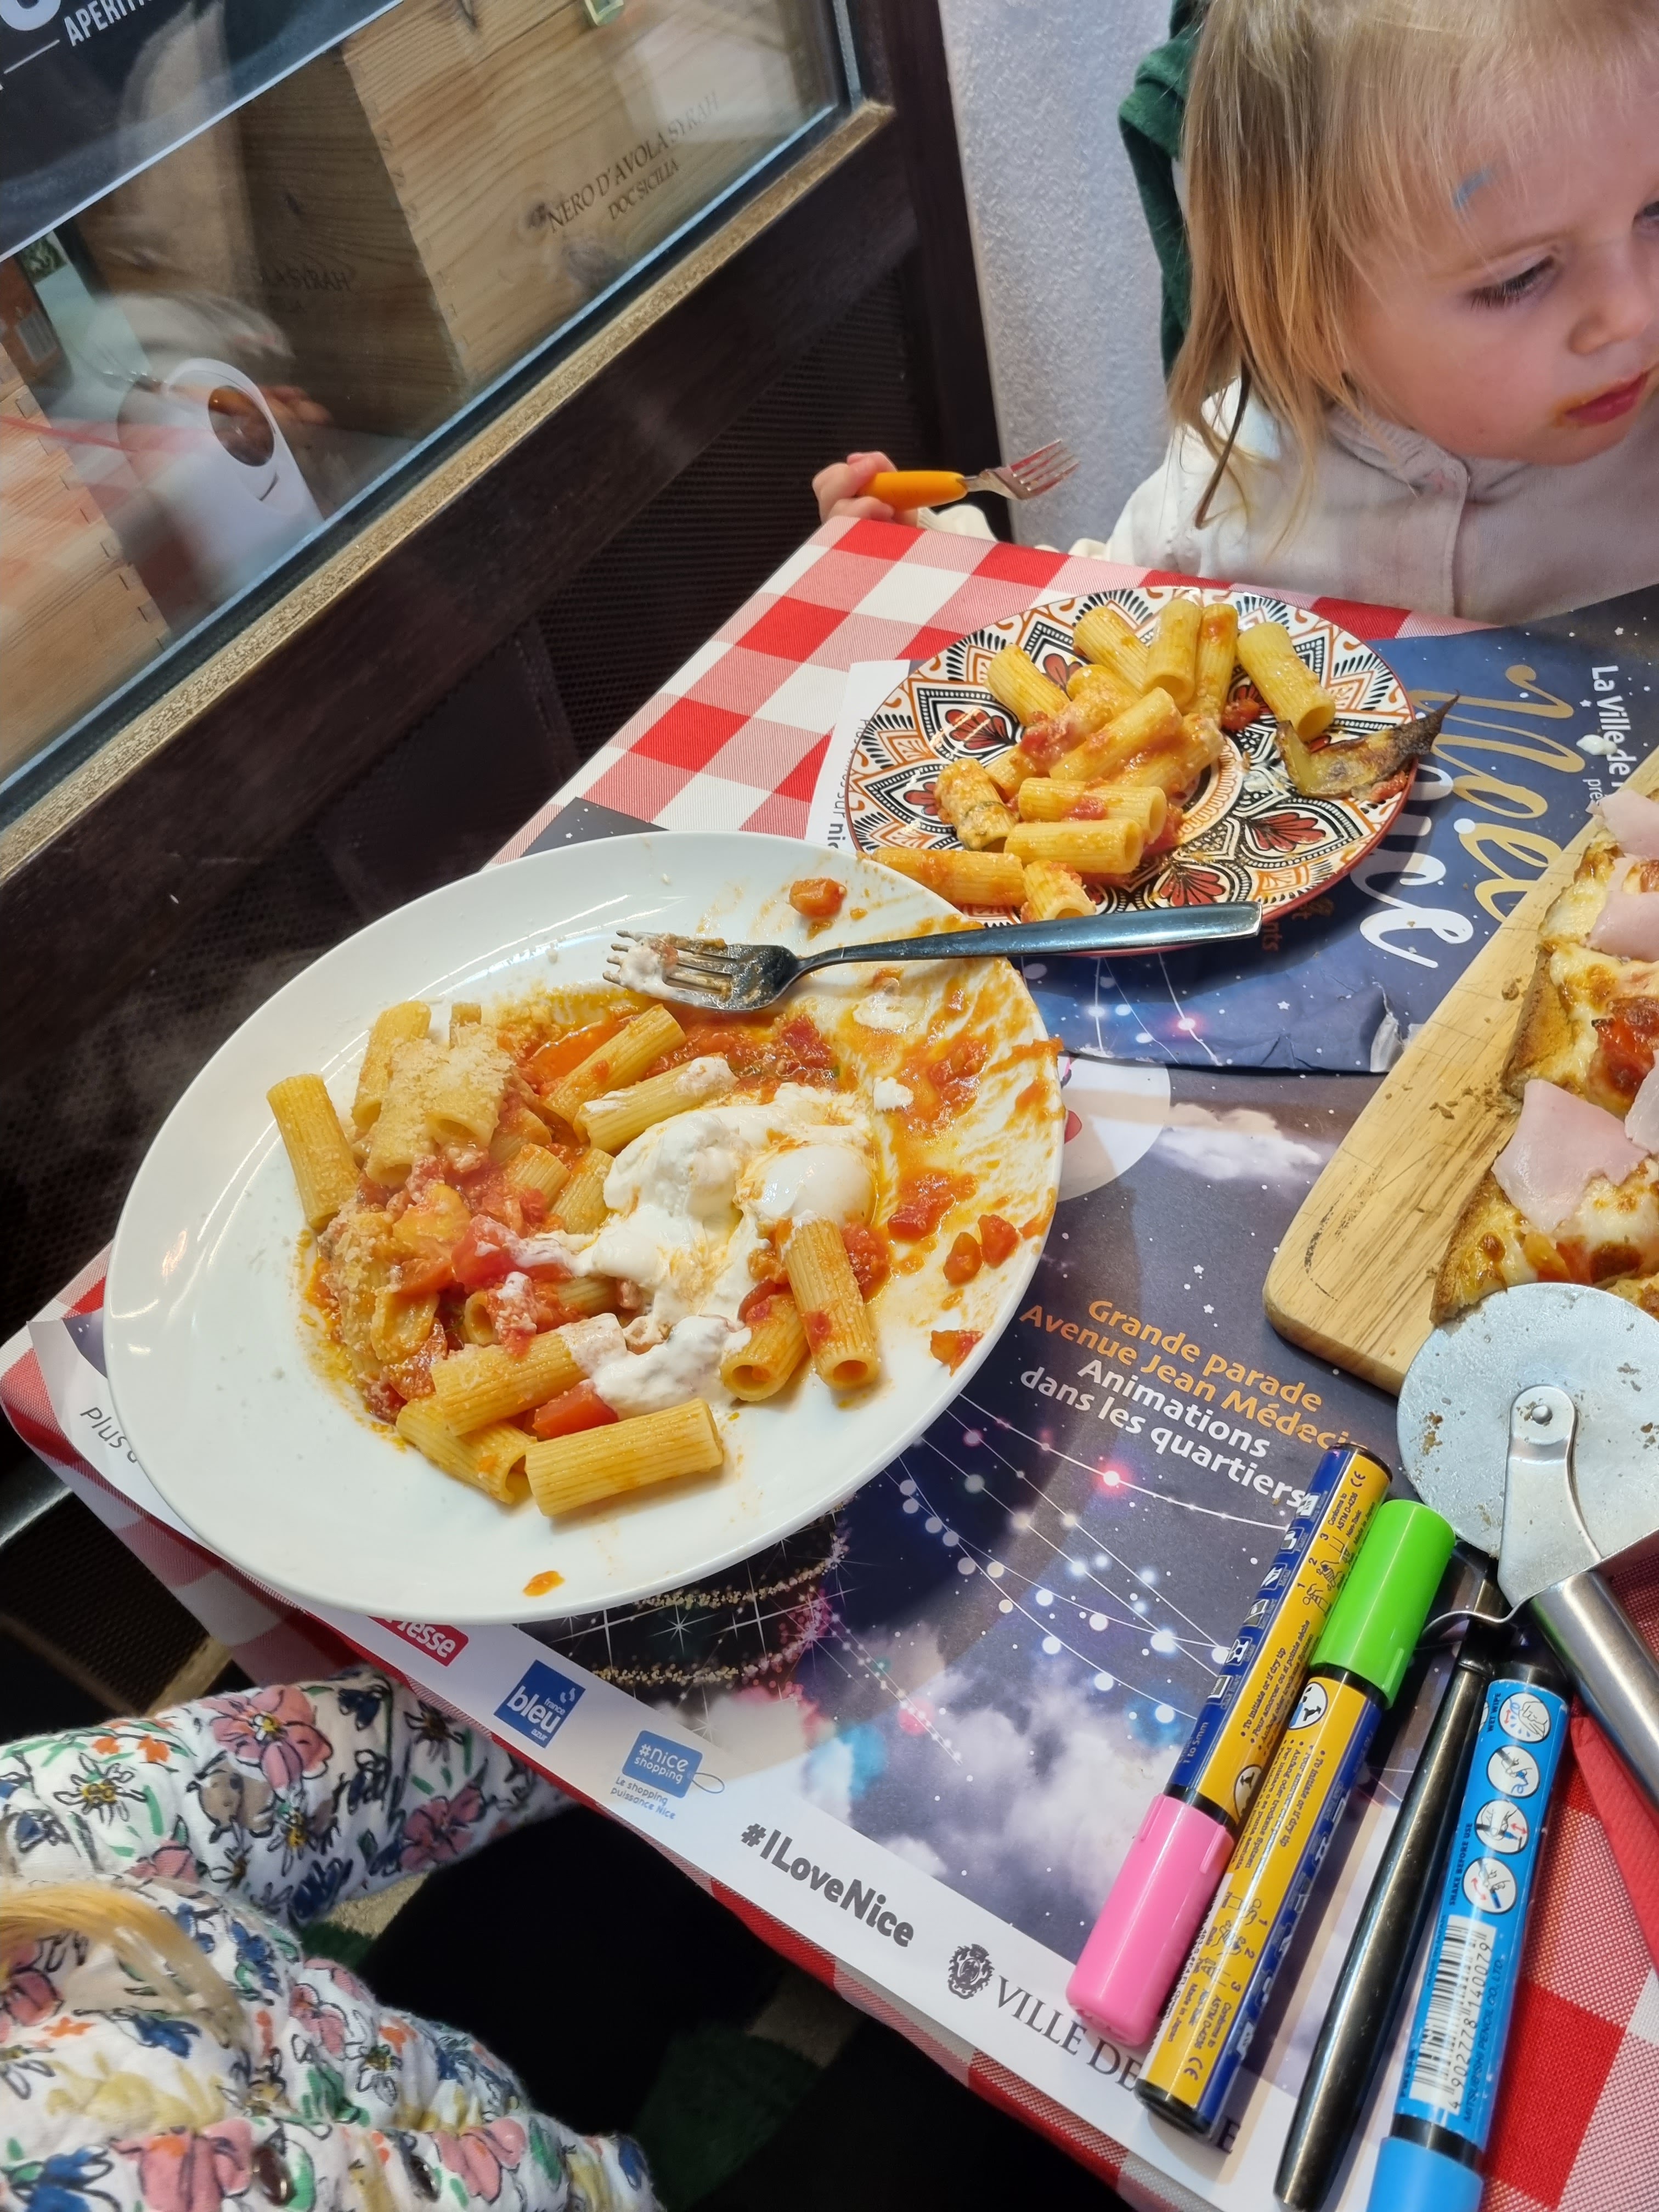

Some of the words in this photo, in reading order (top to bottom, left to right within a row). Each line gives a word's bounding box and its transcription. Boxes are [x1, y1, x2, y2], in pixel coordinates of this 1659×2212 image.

[64, 0, 153, 46] APERI
[548, 184, 595, 233] NERO
[1590, 663, 1622, 693] La
[1596, 694, 1633, 746] Ville
[1605, 747, 1639, 777] de
[1088, 1300, 1200, 1362] Grande
[1202, 1355, 1322, 1413] Parade
[1019, 1305, 1137, 1365] Avenue
[1140, 1355, 1217, 1401] Jean
[1221, 1390, 1368, 1450] Médec
[1077, 1359, 1271, 1458] Animations
[81, 1406, 127, 1448] Plus
[1020, 1367, 1094, 1412] dans
[1097, 1397, 1147, 1434] les
[1150, 1426, 1307, 1509] quartiers
[1327, 1498, 1345, 1526] Conforms
[1335, 1511, 1349, 1531] ASTM
[1343, 1491, 1358, 1513] D-4236
[1344, 1509, 1363, 1538] Non-Toxic
[1319, 1532, 1329, 1541] 3
[1307, 1556, 1318, 1566] 2
[1242, 1718, 1252, 1730] To
[1247, 1690, 1266, 1719] initiate
[1261, 1679, 1271, 1690] or
[1268, 1657, 1282, 1674] dry
[1276, 1646, 1287, 1659] tip
[1251, 1717, 1266, 1736] Pour
[1261, 1683, 1281, 1717] amorcer
[1284, 1640, 1301, 1666] pointe
[1490, 1691, 1502, 1713] WIPE
[507, 1686, 561, 1734] bleu
[544, 1697, 566, 1714] france
[531, 1729, 548, 1742] azur
[1486, 1714, 1497, 1733] WET
[639, 1743, 689, 1772] #nice
[1187, 1746, 1197, 1758] to
[1283, 1748, 1301, 1779] Anfang
[1313, 1757, 1324, 1769] To
[634, 1757, 684, 1784] shopping
[1300, 1768, 1318, 1799] initiate
[610, 1787, 654, 1810] puissance
[655, 1805, 676, 1819] Nice
[616, 1776, 625, 1786] Le
[627, 1782, 669, 1806] shopping
[1274, 1778, 1288, 1799] oder
[1259, 1798, 1280, 1837] trockene
[1295, 1799, 1305, 1810] or
[1278, 1834, 1290, 1848] tip
[1284, 1818, 1297, 1835] dry
[1462, 1821, 1473, 1839] USE
[1244, 1836, 1263, 1870] Spitzen
[1454, 1839, 1470, 1875] BEFORE
[741, 1822, 915, 1947] #ILoveNice
[1447, 1876, 1462, 1906] SHAKE
[1257, 1917, 1268, 1926] 1
[1243, 1946, 1256, 1960] 2
[1229, 1980, 1243, 1993] 3
[1464, 1942, 1496, 2009] 140079
[1182, 1982, 1198, 2006] Made
[1205, 1995, 1222, 2021] ASTM
[996, 1976, 1088, 2056] VILLE
[1475, 2007, 1495, 2050] PENCIL
[1447, 2017, 1480, 2089] 902778
[1447, 2100, 1460, 2109] 4
